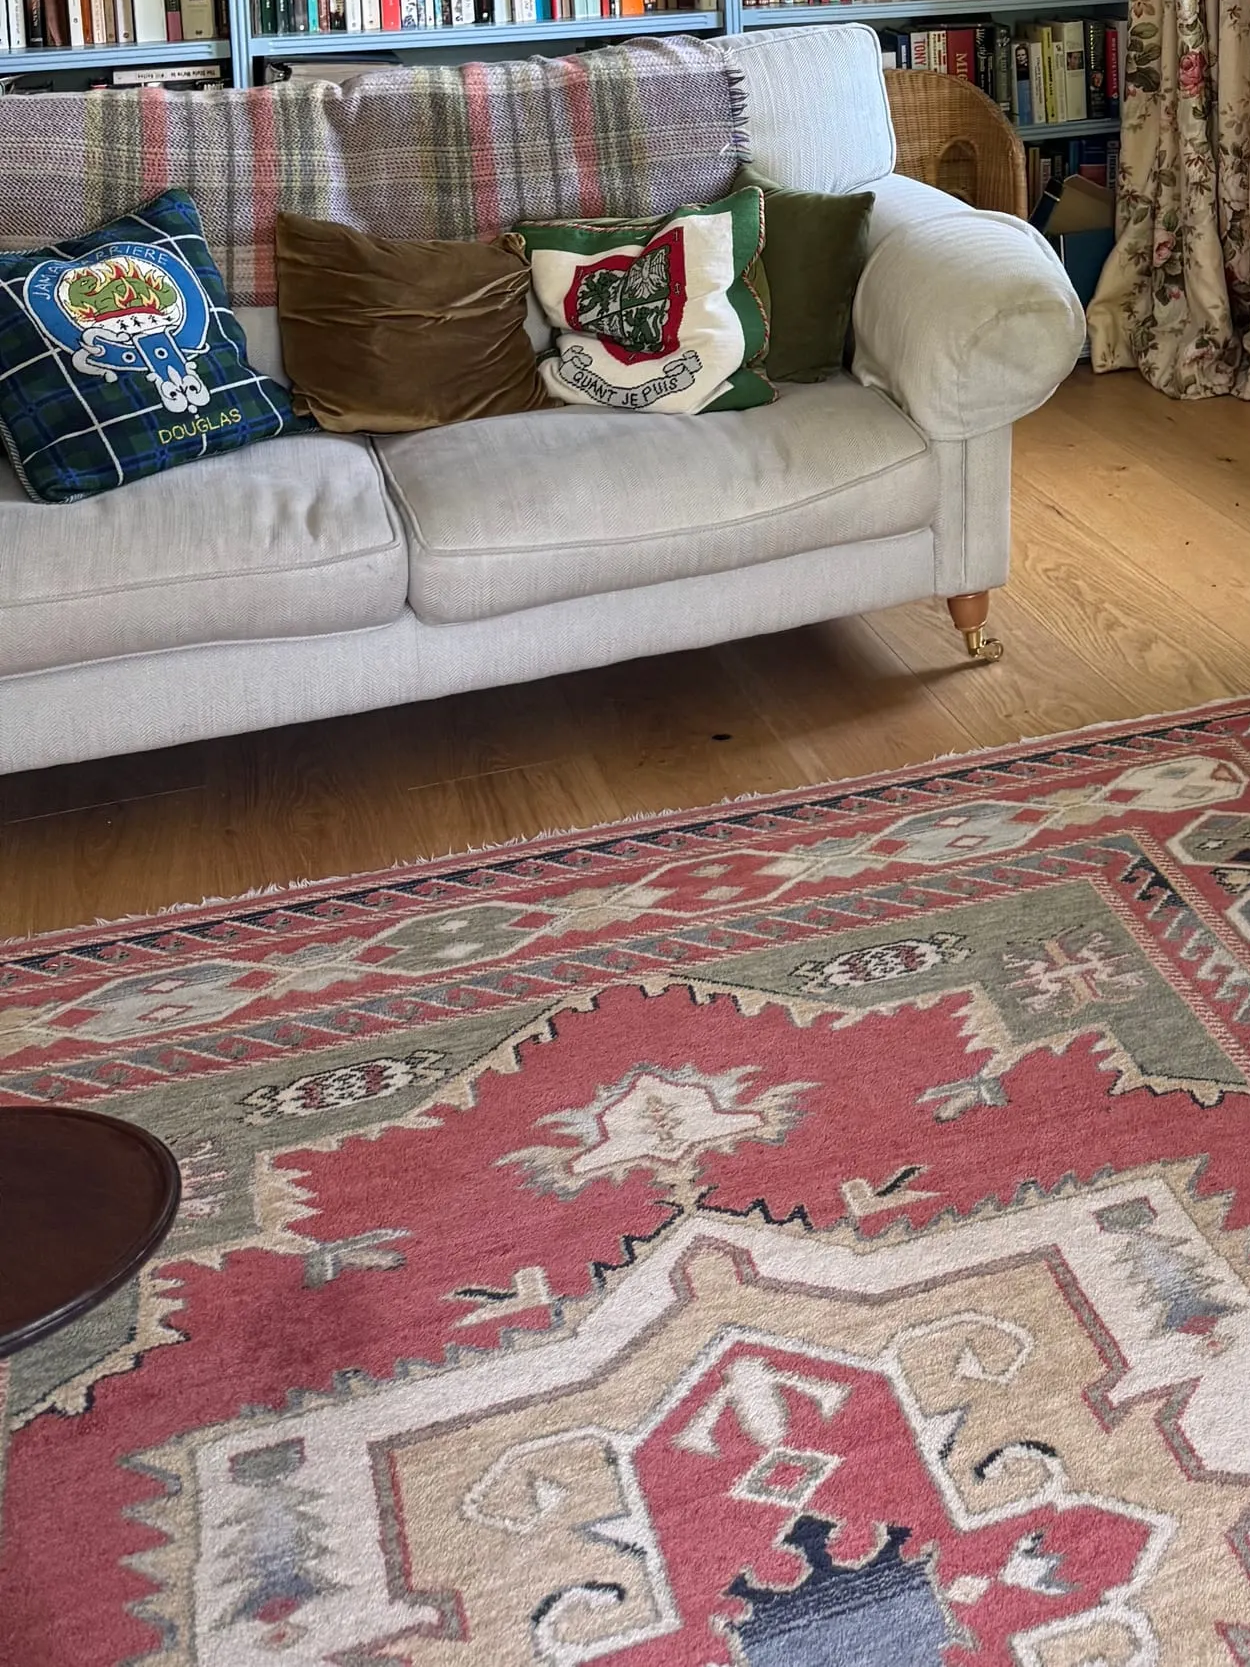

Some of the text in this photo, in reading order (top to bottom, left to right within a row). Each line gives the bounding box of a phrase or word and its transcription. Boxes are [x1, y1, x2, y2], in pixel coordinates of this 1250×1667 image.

[914, 38, 926, 65] TONY
[573, 371, 678, 406] QUANT JE PUIS
[158, 407, 243, 446] DOUGLAS
